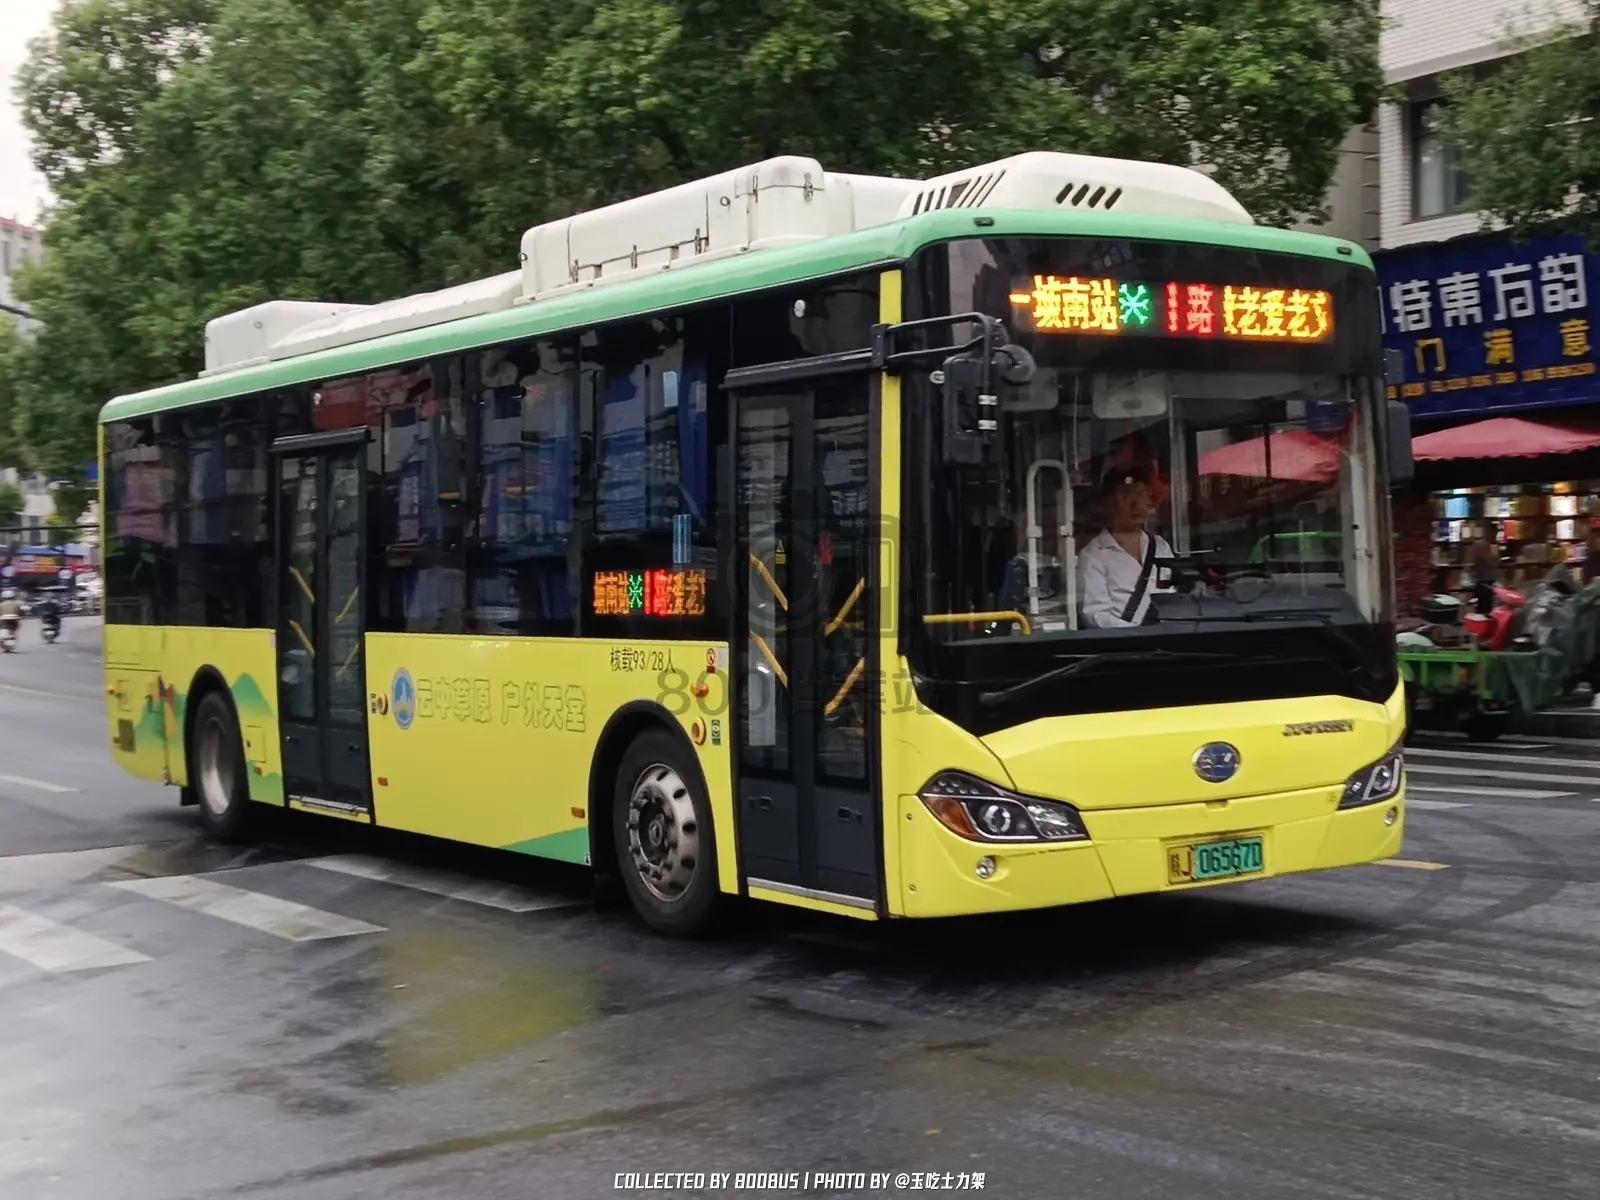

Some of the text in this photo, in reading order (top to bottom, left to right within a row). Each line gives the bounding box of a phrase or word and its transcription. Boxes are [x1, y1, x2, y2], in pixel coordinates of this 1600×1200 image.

[1377, 253, 1588, 334] 特東方韵
[610, 646, 676, 673] 核载93/28人
